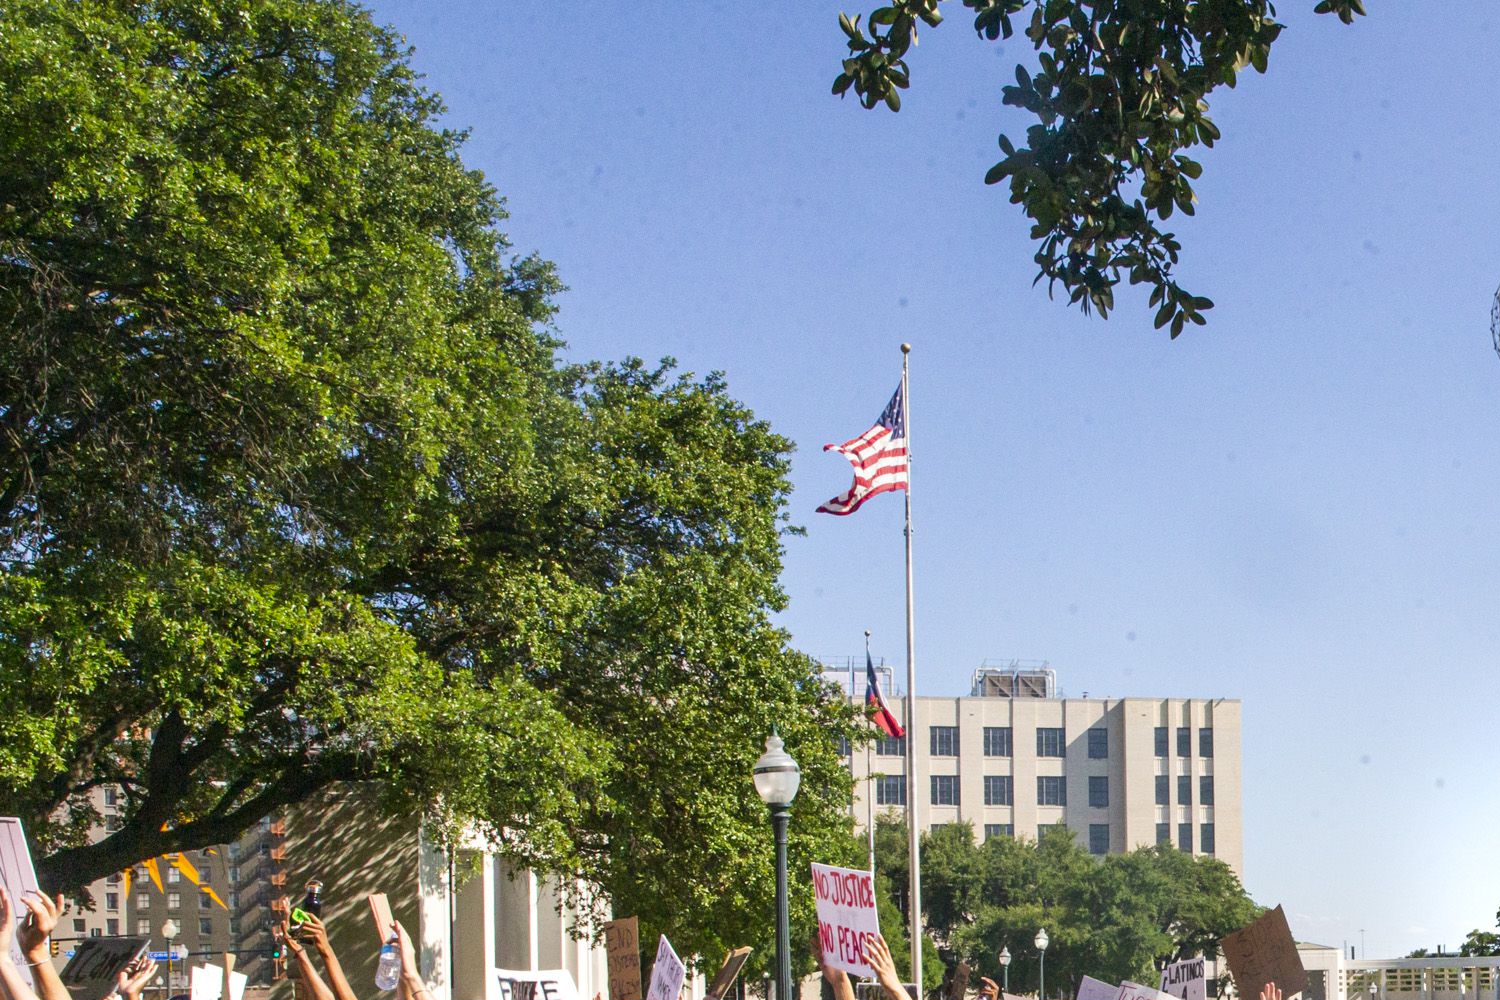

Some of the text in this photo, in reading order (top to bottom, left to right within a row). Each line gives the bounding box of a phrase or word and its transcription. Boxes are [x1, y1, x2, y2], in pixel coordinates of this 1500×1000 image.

[813, 868, 874, 909] NO JUSTICE
[606, 925, 633, 953] END
[818, 919, 834, 954] NO
[1168, 959, 1205, 985] LATINOS
